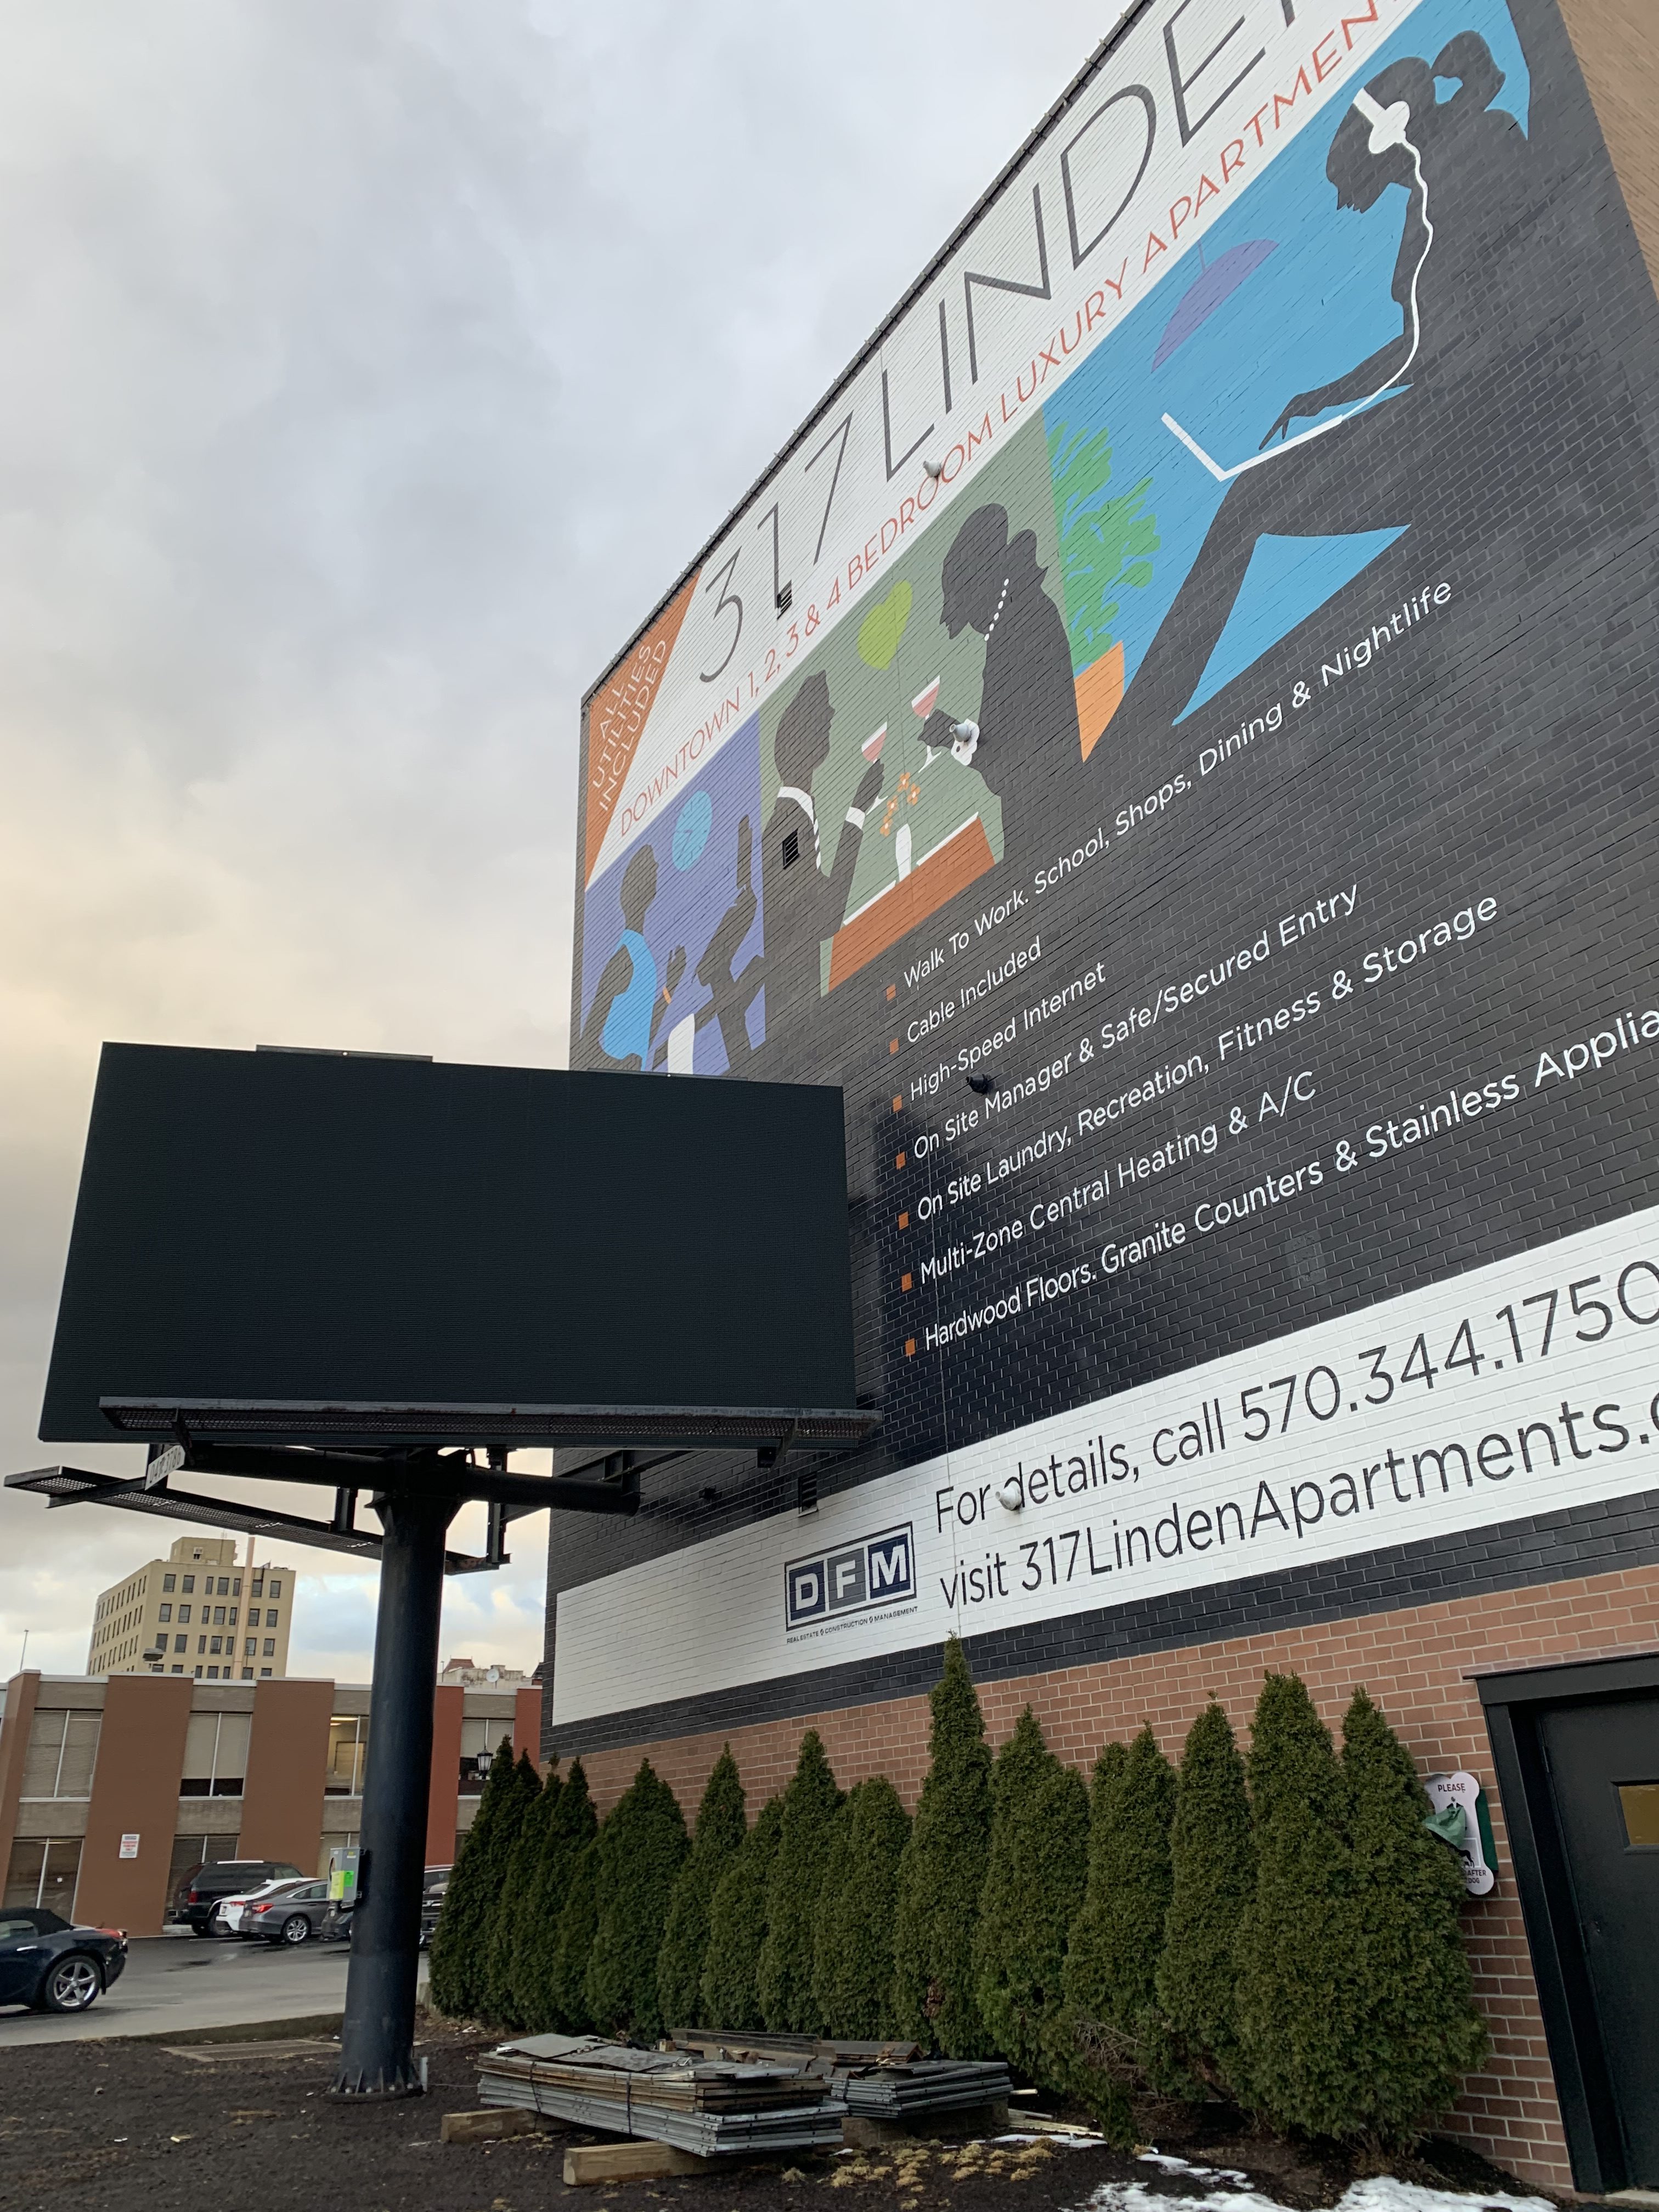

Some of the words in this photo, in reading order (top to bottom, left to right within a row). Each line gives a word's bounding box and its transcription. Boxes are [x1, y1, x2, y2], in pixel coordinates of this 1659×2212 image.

[699, 410, 854, 683] 317
[882, 0, 1295, 482] LINDE
[621, 686, 740, 837] DOWNTOWN
[748, 671, 759, 698] 1,
[764, 648, 781, 682] 2,
[786, 621, 799, 657] 3
[805, 604, 821, 636] &
[826, 576, 842, 610] 4
[848, 411, 993, 591] BEDROOM
[1001, 256, 1129, 424] LUXURY
[592, 645, 651, 788] UTILITIES
[599, 640, 667, 811] INCLUDED
[600, 682, 624, 740] ALL
[903, 940, 945, 988] Walk
[949, 930, 970, 955] To
[1035, 827, 1110, 894] School,
[1115, 772, 1193, 835] Shops,
[1198, 703, 1283, 777] Dining
[1292, 680, 1312, 708] &
[1321, 581, 1453, 687] Nightlife
[907, 999, 955, 1043] Cable
[961, 936, 1042, 1009] Included
[910, 1016, 1017, 1101] High-Speed
[1024, 962, 1107, 1030] Internet
[913, 1133, 939, 1159] On
[945, 1107, 979, 1141] Site
[985, 1051, 1073, 1120] Manager
[1079, 1037, 1095, 1063] &
[1101, 931, 1269, 1049] Safe/Secured
[1278, 884, 1358, 947] Entry
[917, 1192, 943, 1220] On
[947, 1171, 981, 1206] Site
[986, 1123, 1073, 1185] Laundry,
[1078, 1053, 1210, 1136] Recreation,
[1218, 990, 1322, 1061] Fitness
[1331, 969, 1354, 1000] &
[1363, 896, 1498, 983] Storage
[921, 1219, 1024, 1284] Multi-Zone
[1030, 1170, 1110, 1230] Central
[1118, 1123, 1218, 1189] Heating
[1228, 1106, 1248, 1135] &
[1258, 1070, 1317, 1122] A/C
[926, 1285, 1021, 1351] Hardwood
[1027, 1261, 1097, 1307] Floors.
[1101, 1221, 1186, 1274] Granite
[1194, 1160, 1324, 1233] Counters
[1335, 1140, 1358, 1173] &
[1366, 1073, 1521, 1159] Stainless
[936, 1483, 990, 1533] For
[1153, 1398, 1226, 1466] call
[1240, 1260, 1659, 1442] 570.344.1750
[795, 1543, 906, 1611] DFM
[800, 1631, 819, 1641] ESTATE
[825, 1618, 868, 1634] CONSTRUCTION
[874, 1606, 918, 1622] MANAGEMENT
[940, 1551, 1009, 1609] visit
[1437, 1783, 1466, 1793] PLEASE
